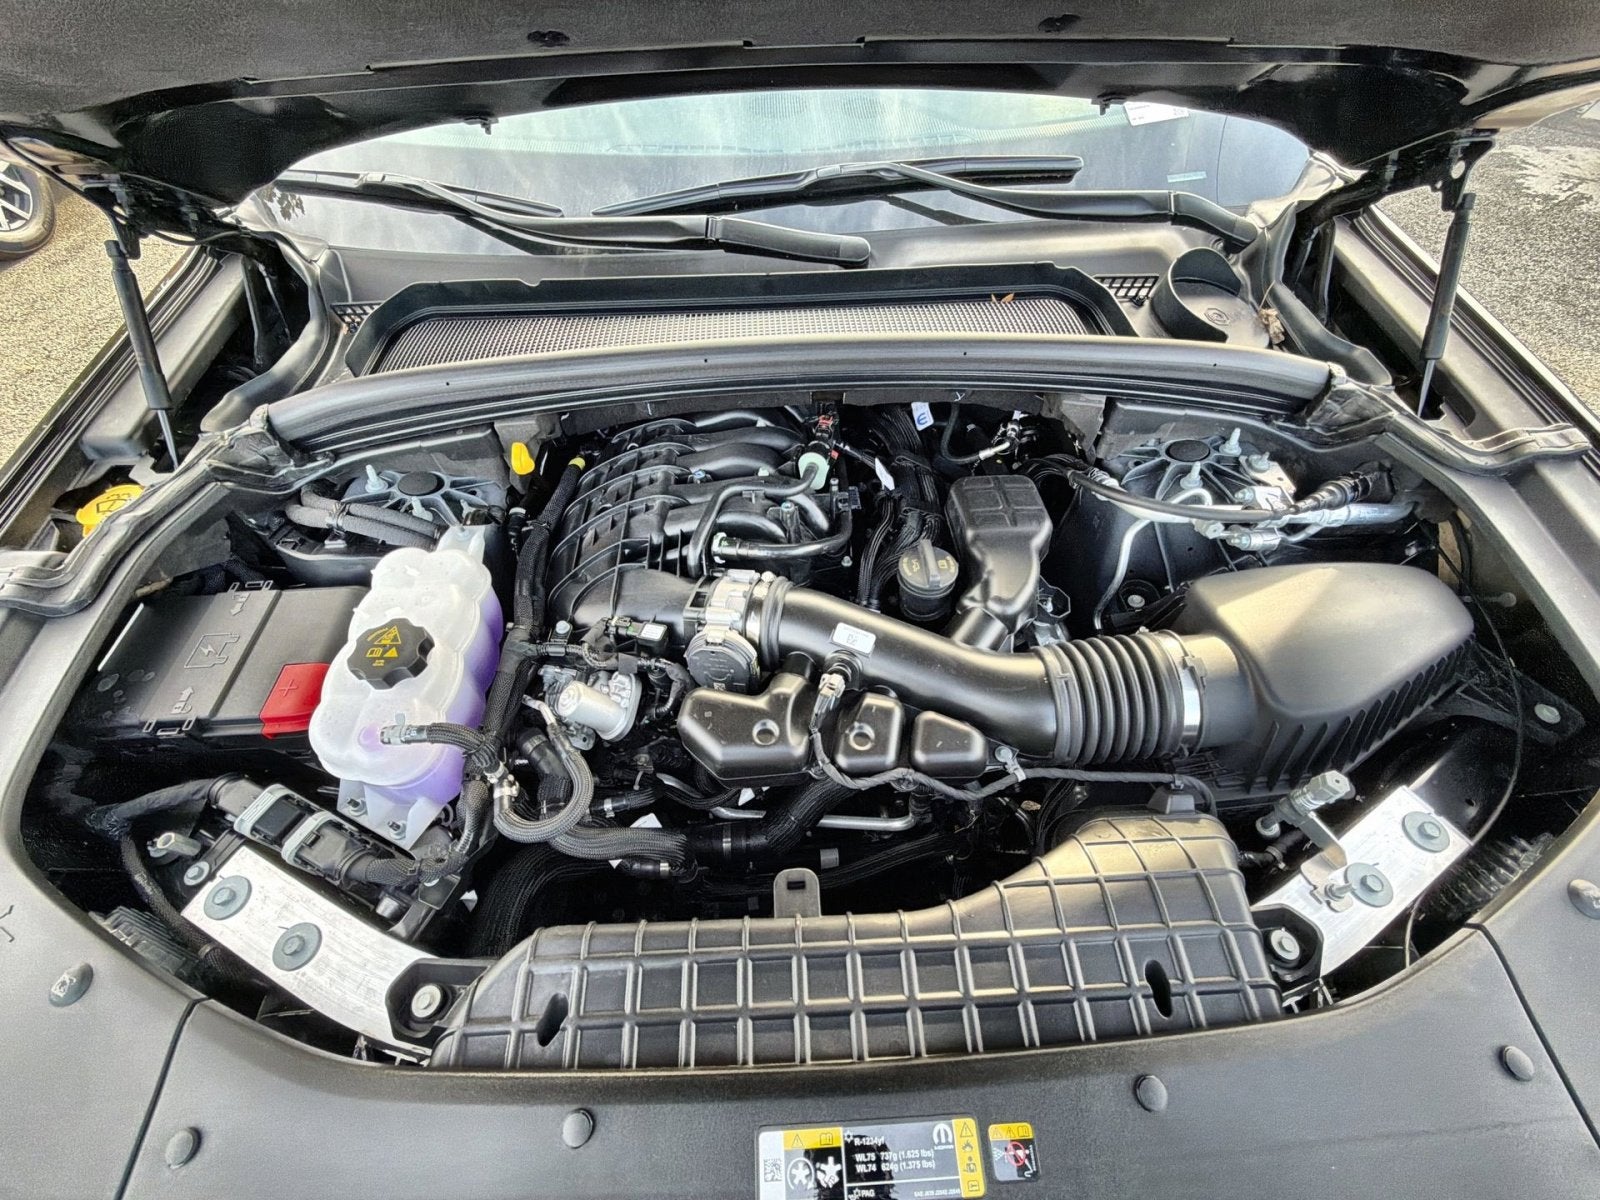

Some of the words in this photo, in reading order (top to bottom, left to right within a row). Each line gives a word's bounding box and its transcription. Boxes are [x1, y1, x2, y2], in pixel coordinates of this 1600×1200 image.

[854, 1136, 885, 1147] R-1234yf
[855, 1152, 876, 1162] WL75
[880, 1151, 897, 1161] 737g
[920, 1148, 935, 1159] lbs)
[855, 1163, 877, 1173] WL74
[899, 1160, 921, 1172] (1.375
[921, 1160, 936, 1170] lbs)
[861, 1189, 876, 1198] PAG
